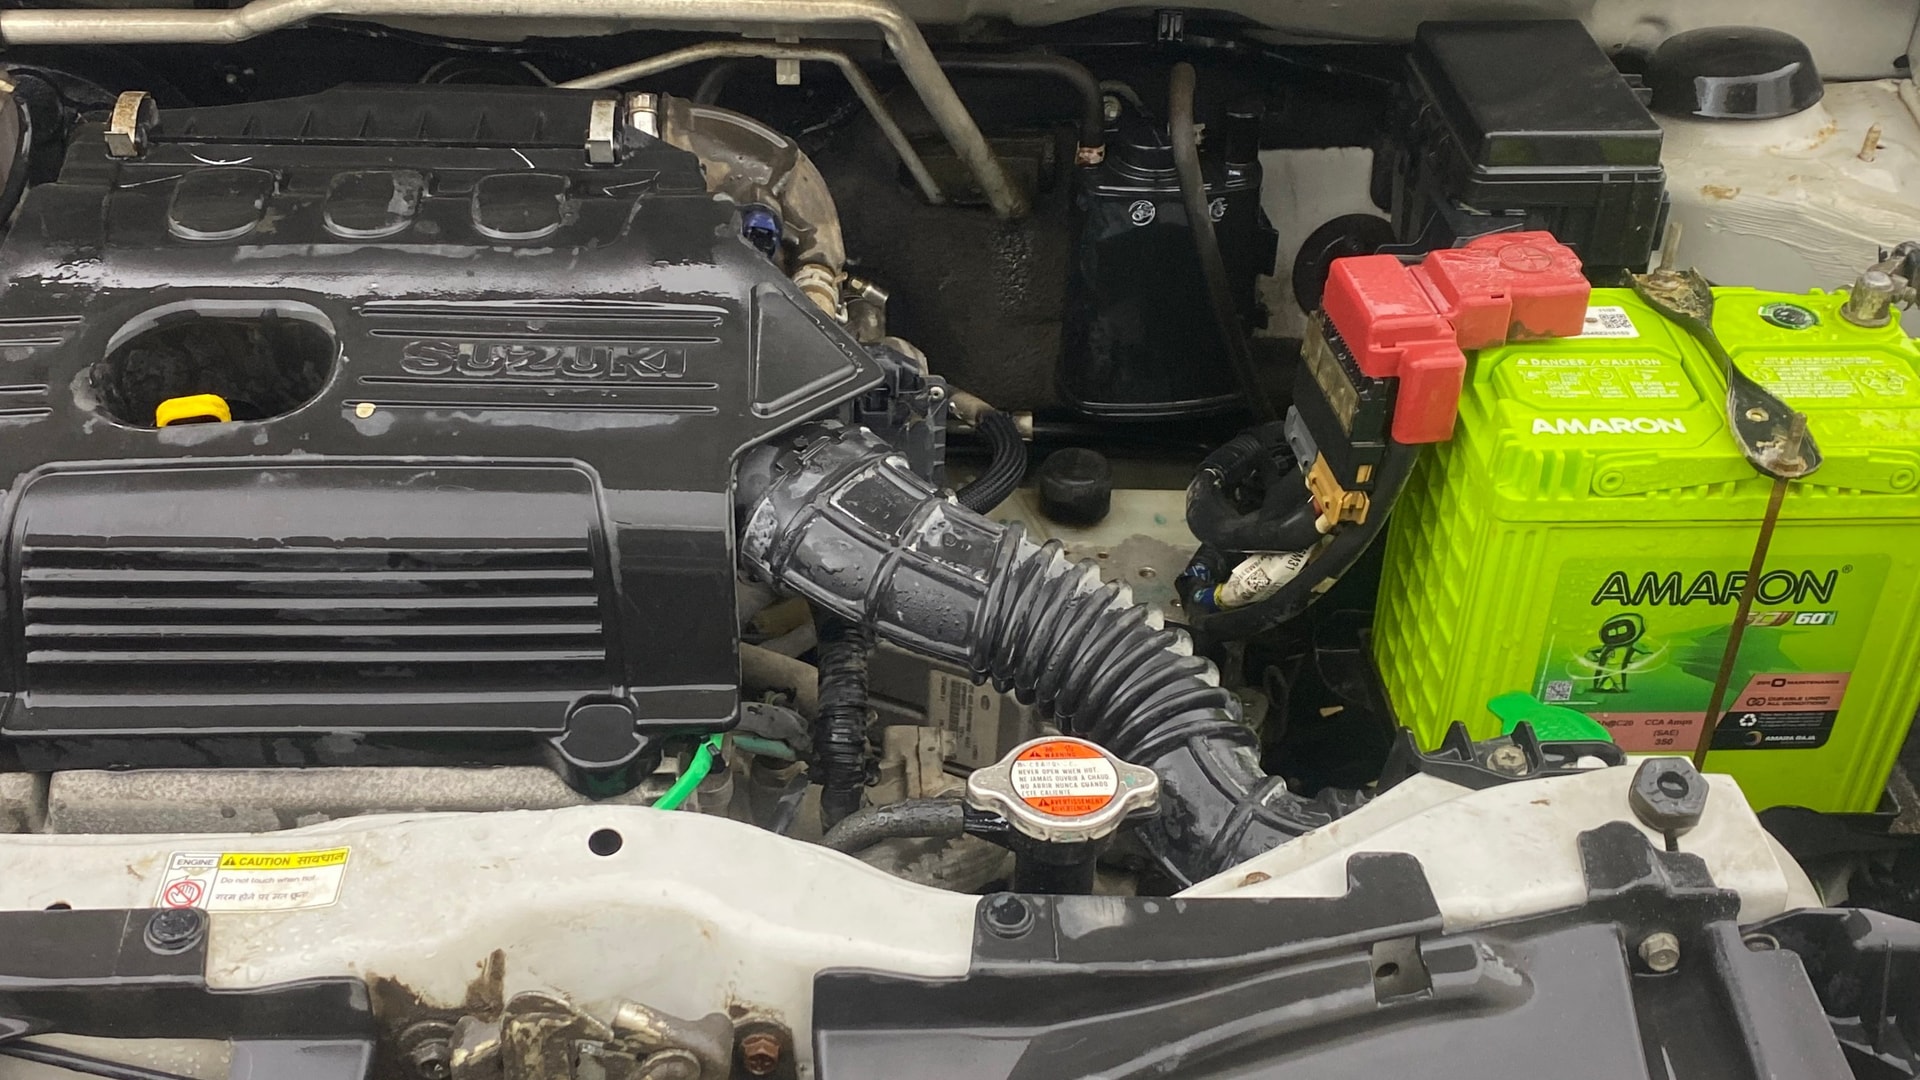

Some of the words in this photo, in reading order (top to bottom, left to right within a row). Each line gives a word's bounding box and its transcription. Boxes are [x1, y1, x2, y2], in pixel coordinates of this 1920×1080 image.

[400, 339, 687, 377] SUZUKI
[1530, 358, 1587, 366] DANGER
[1600, 358, 1661, 366] CAUTION
[1532, 417, 1687, 434] AMARON
[1591, 569, 1838, 606] AMARON
[1668, 719, 1693, 727] Amps
[177, 858, 214, 866] ENGINE
[239, 857, 291, 866] CAUTION
[297, 851, 346, 864] सावधान
